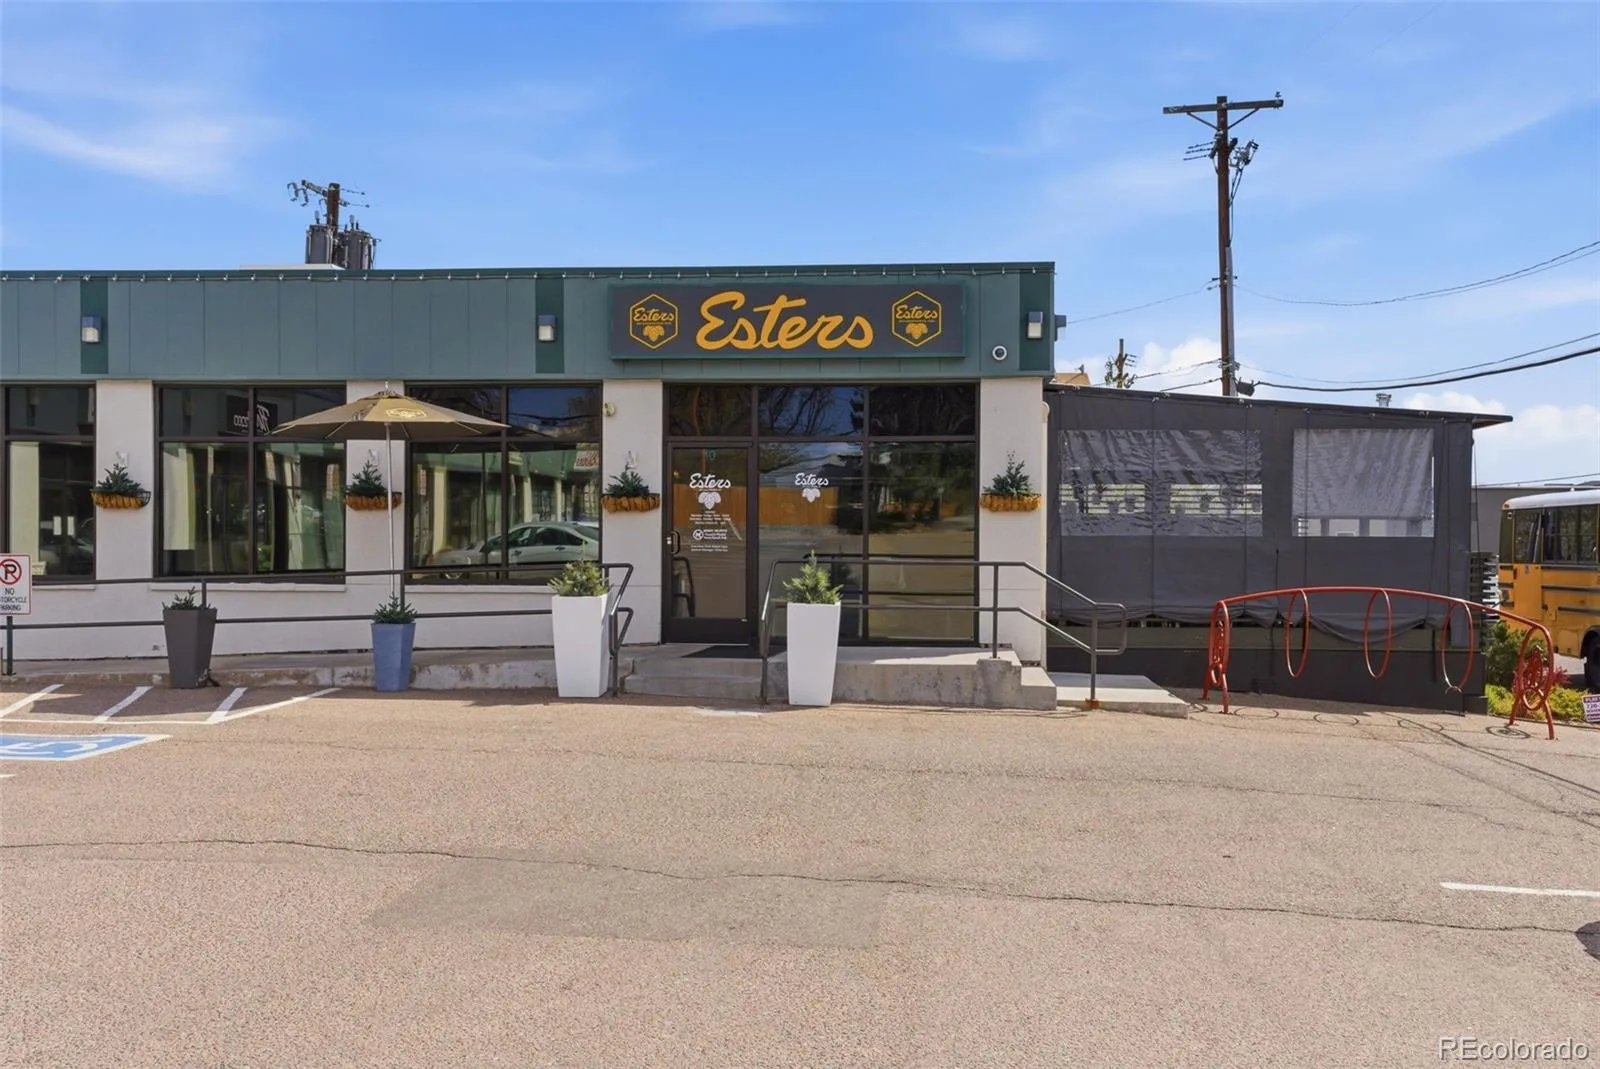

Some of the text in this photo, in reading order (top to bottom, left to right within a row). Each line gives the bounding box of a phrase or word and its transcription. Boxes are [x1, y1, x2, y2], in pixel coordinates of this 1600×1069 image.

[633, 307, 674, 322] Esters
[895, 304, 938, 319] Esters
[696, 291, 874, 350] Esters
[689, 472, 731, 489] Esters
[795, 472, 829, 486] Esters
[5, 587, 15, 595] NO
